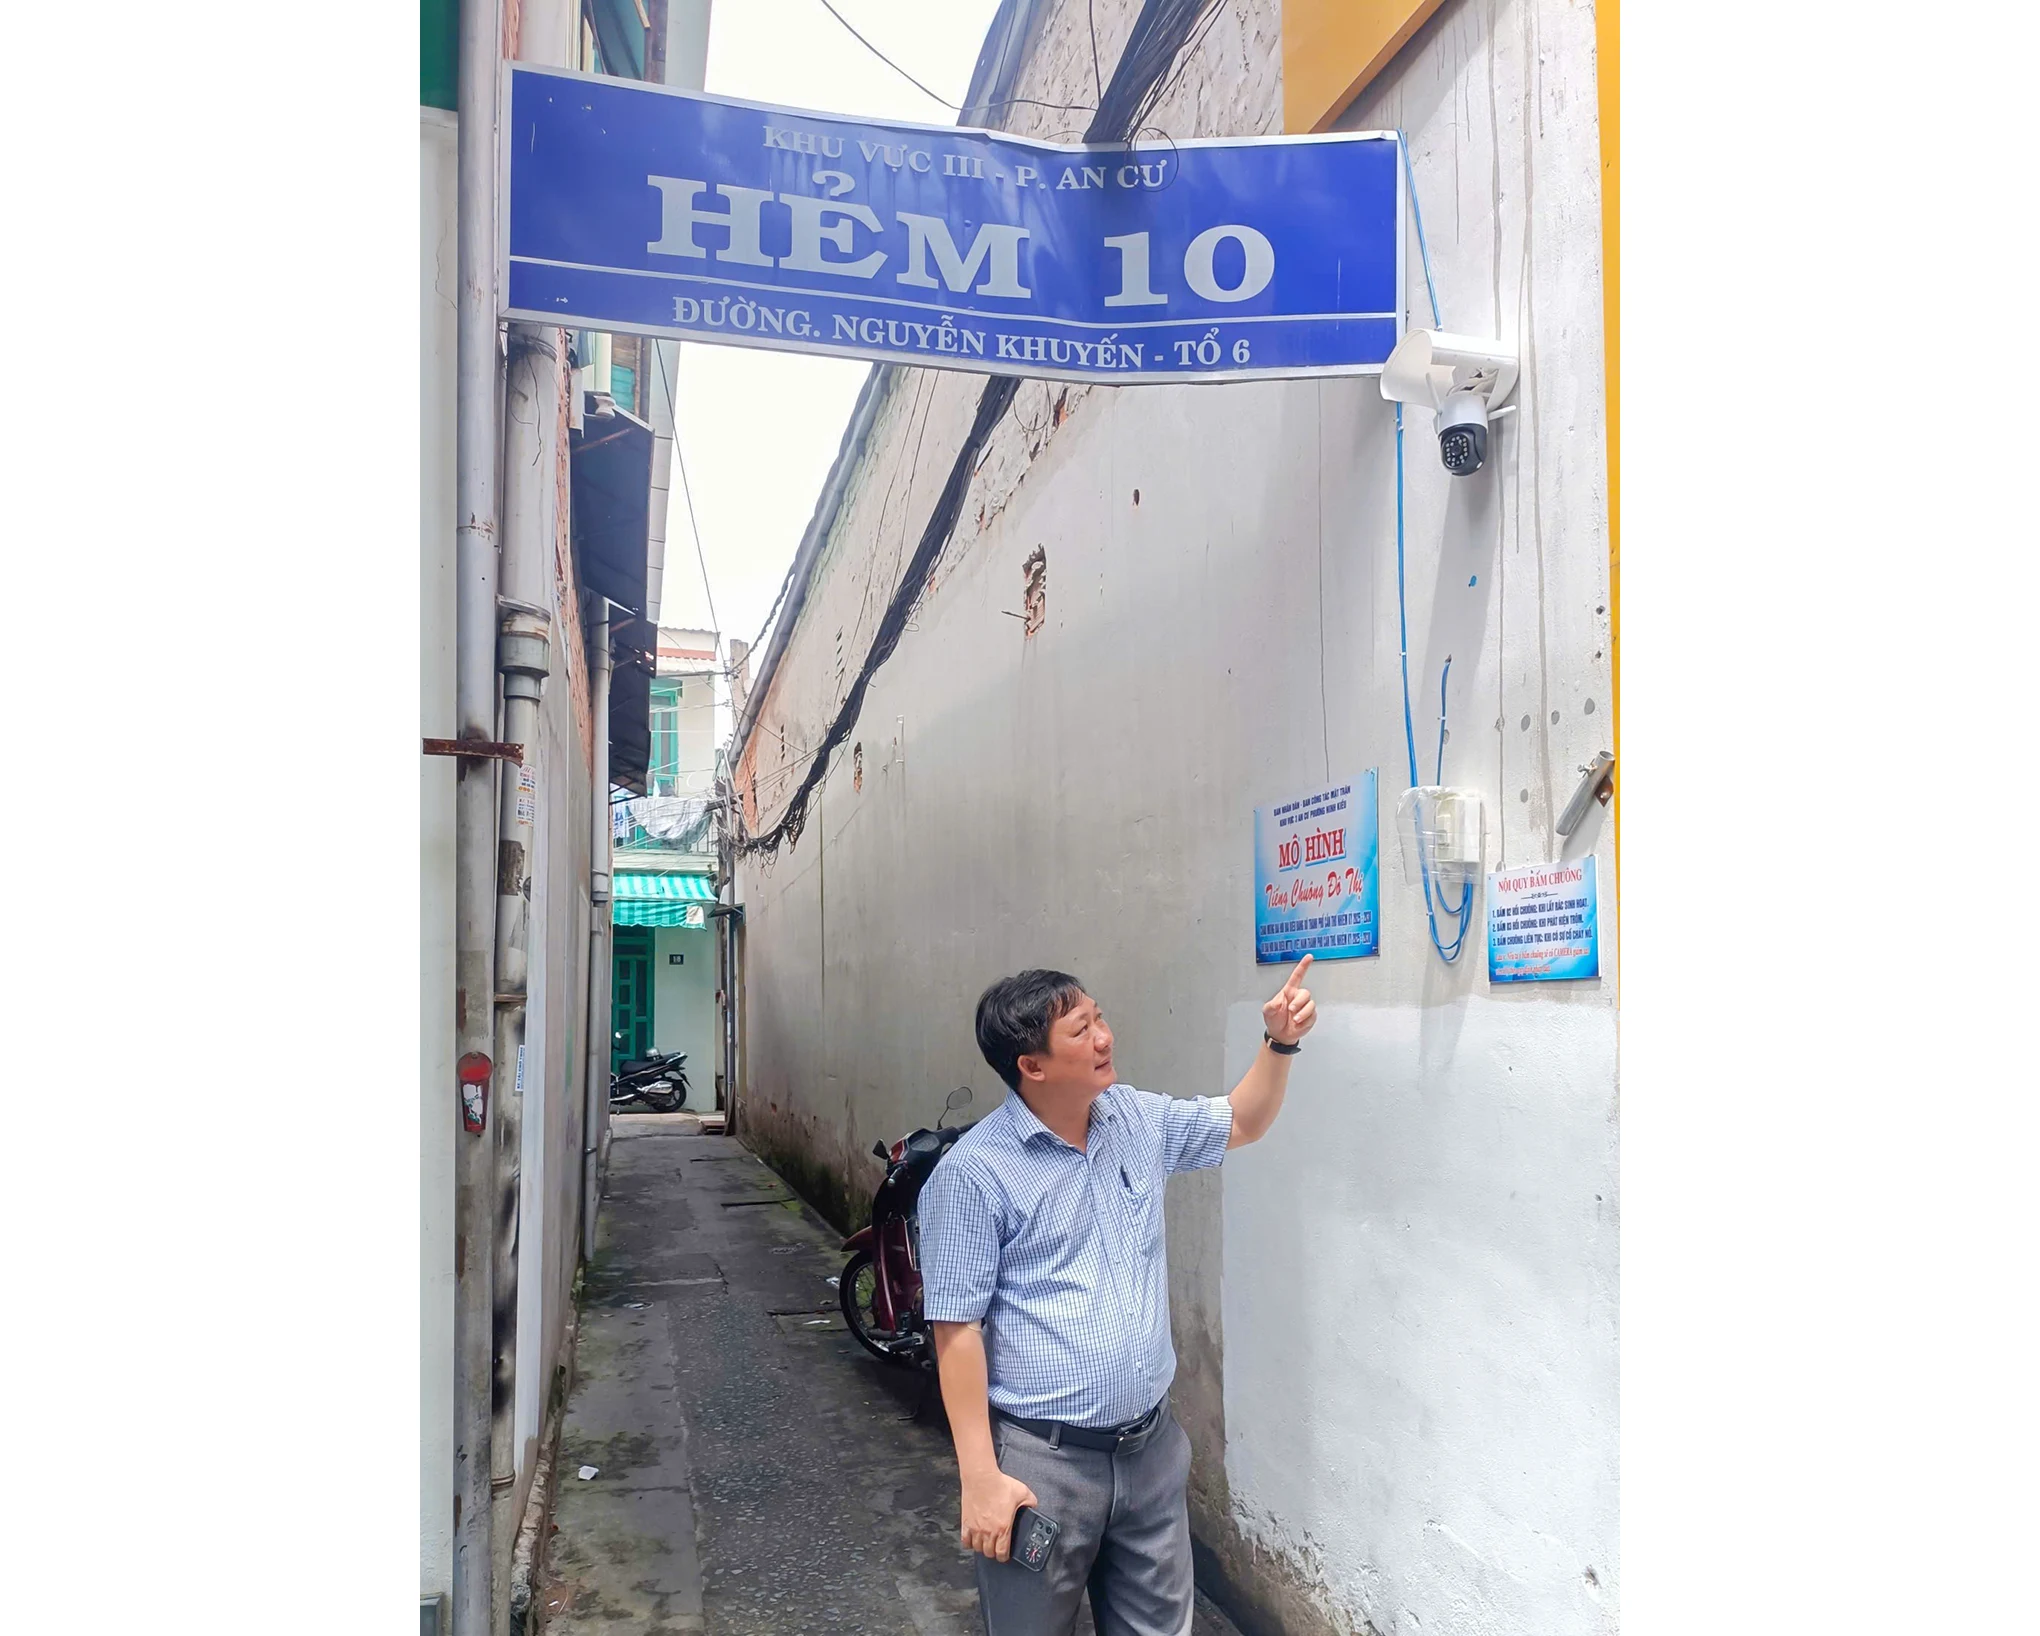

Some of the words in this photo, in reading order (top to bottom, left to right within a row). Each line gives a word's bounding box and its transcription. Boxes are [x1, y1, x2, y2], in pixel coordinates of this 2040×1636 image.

[763, 125, 844, 158] KHU
[857, 140, 931, 173] VỰC
[943, 154, 984, 179] III
[1015, 165, 1046, 189] P.
[1056, 167, 1106, 189] AN
[1116, 159, 1167, 188] CƯ
[646, 170, 1031, 298] HẺM
[1103, 224, 1275, 308] 10
[672, 295, 820, 337] ĐƯỜNG.
[832, 314, 986, 355] NGUYỄN
[995, 333, 1144, 368] KHUYẾN
[1174, 327, 1221, 365] TỔ
[1232, 339, 1250, 364] 6
[1279, 833, 1300, 868] MÔ
[1305, 827, 1344, 862] HÌNH
[1266, 884, 1288, 912] Tiếng
[1291, 879, 1323, 907] Chuông
[1328, 871, 1341, 897] Đô
[1346, 868, 1363, 900] Thị
[1498, 877, 1511, 893] NỘI
[1513, 877, 1528, 892] QUY
[1530, 870, 1547, 888] BẤM
[1549, 867, 1582, 885] CHUÔNG
